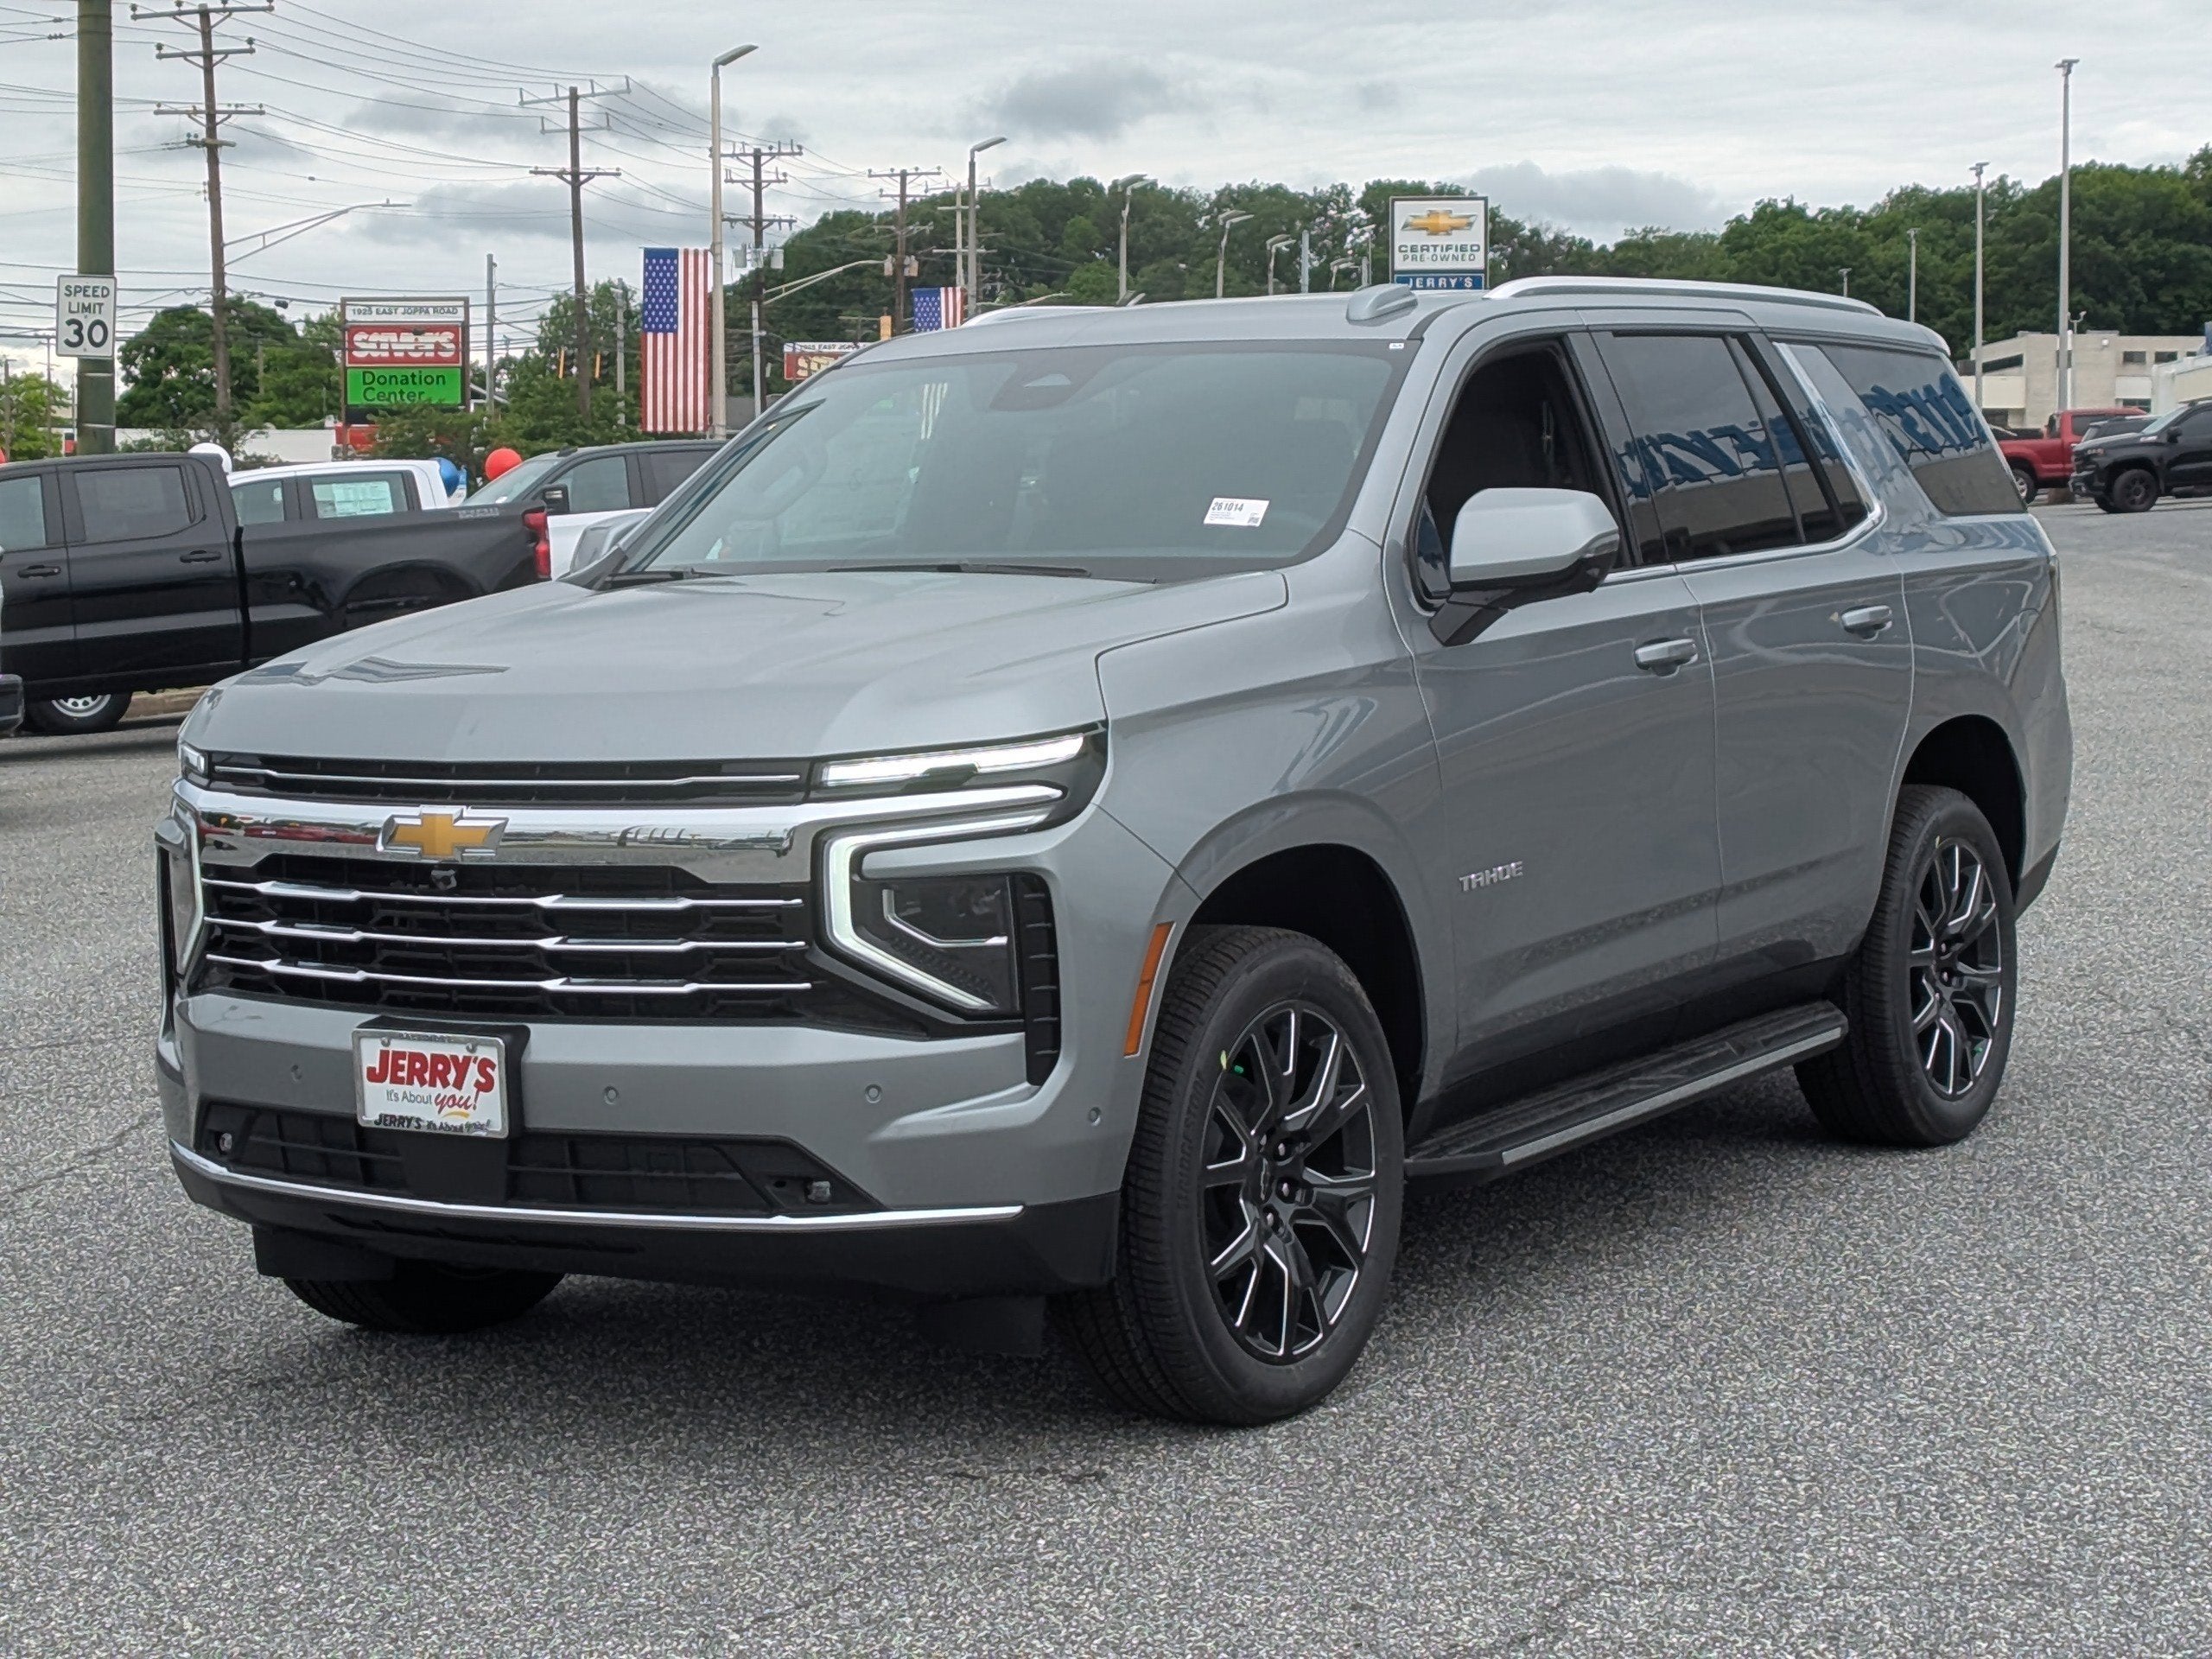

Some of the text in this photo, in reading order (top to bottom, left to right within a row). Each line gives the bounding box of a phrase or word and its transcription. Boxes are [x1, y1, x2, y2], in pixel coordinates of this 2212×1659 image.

[1398, 244, 1481, 253] CERTIFIED
[1408, 277, 1473, 289] JERRY'S
[64, 284, 110, 298] SPEED
[68, 302, 105, 315] LIMIT
[64, 318, 108, 348] 30
[362, 370, 447, 385] Donation
[363, 387, 425, 402] Center
[1211, 501, 1244, 512] 261014
[1459, 861, 1523, 892] TAHOE
[366, 1050, 497, 1093] JERRY'S
[386, 1090, 480, 1115] It's About you!
